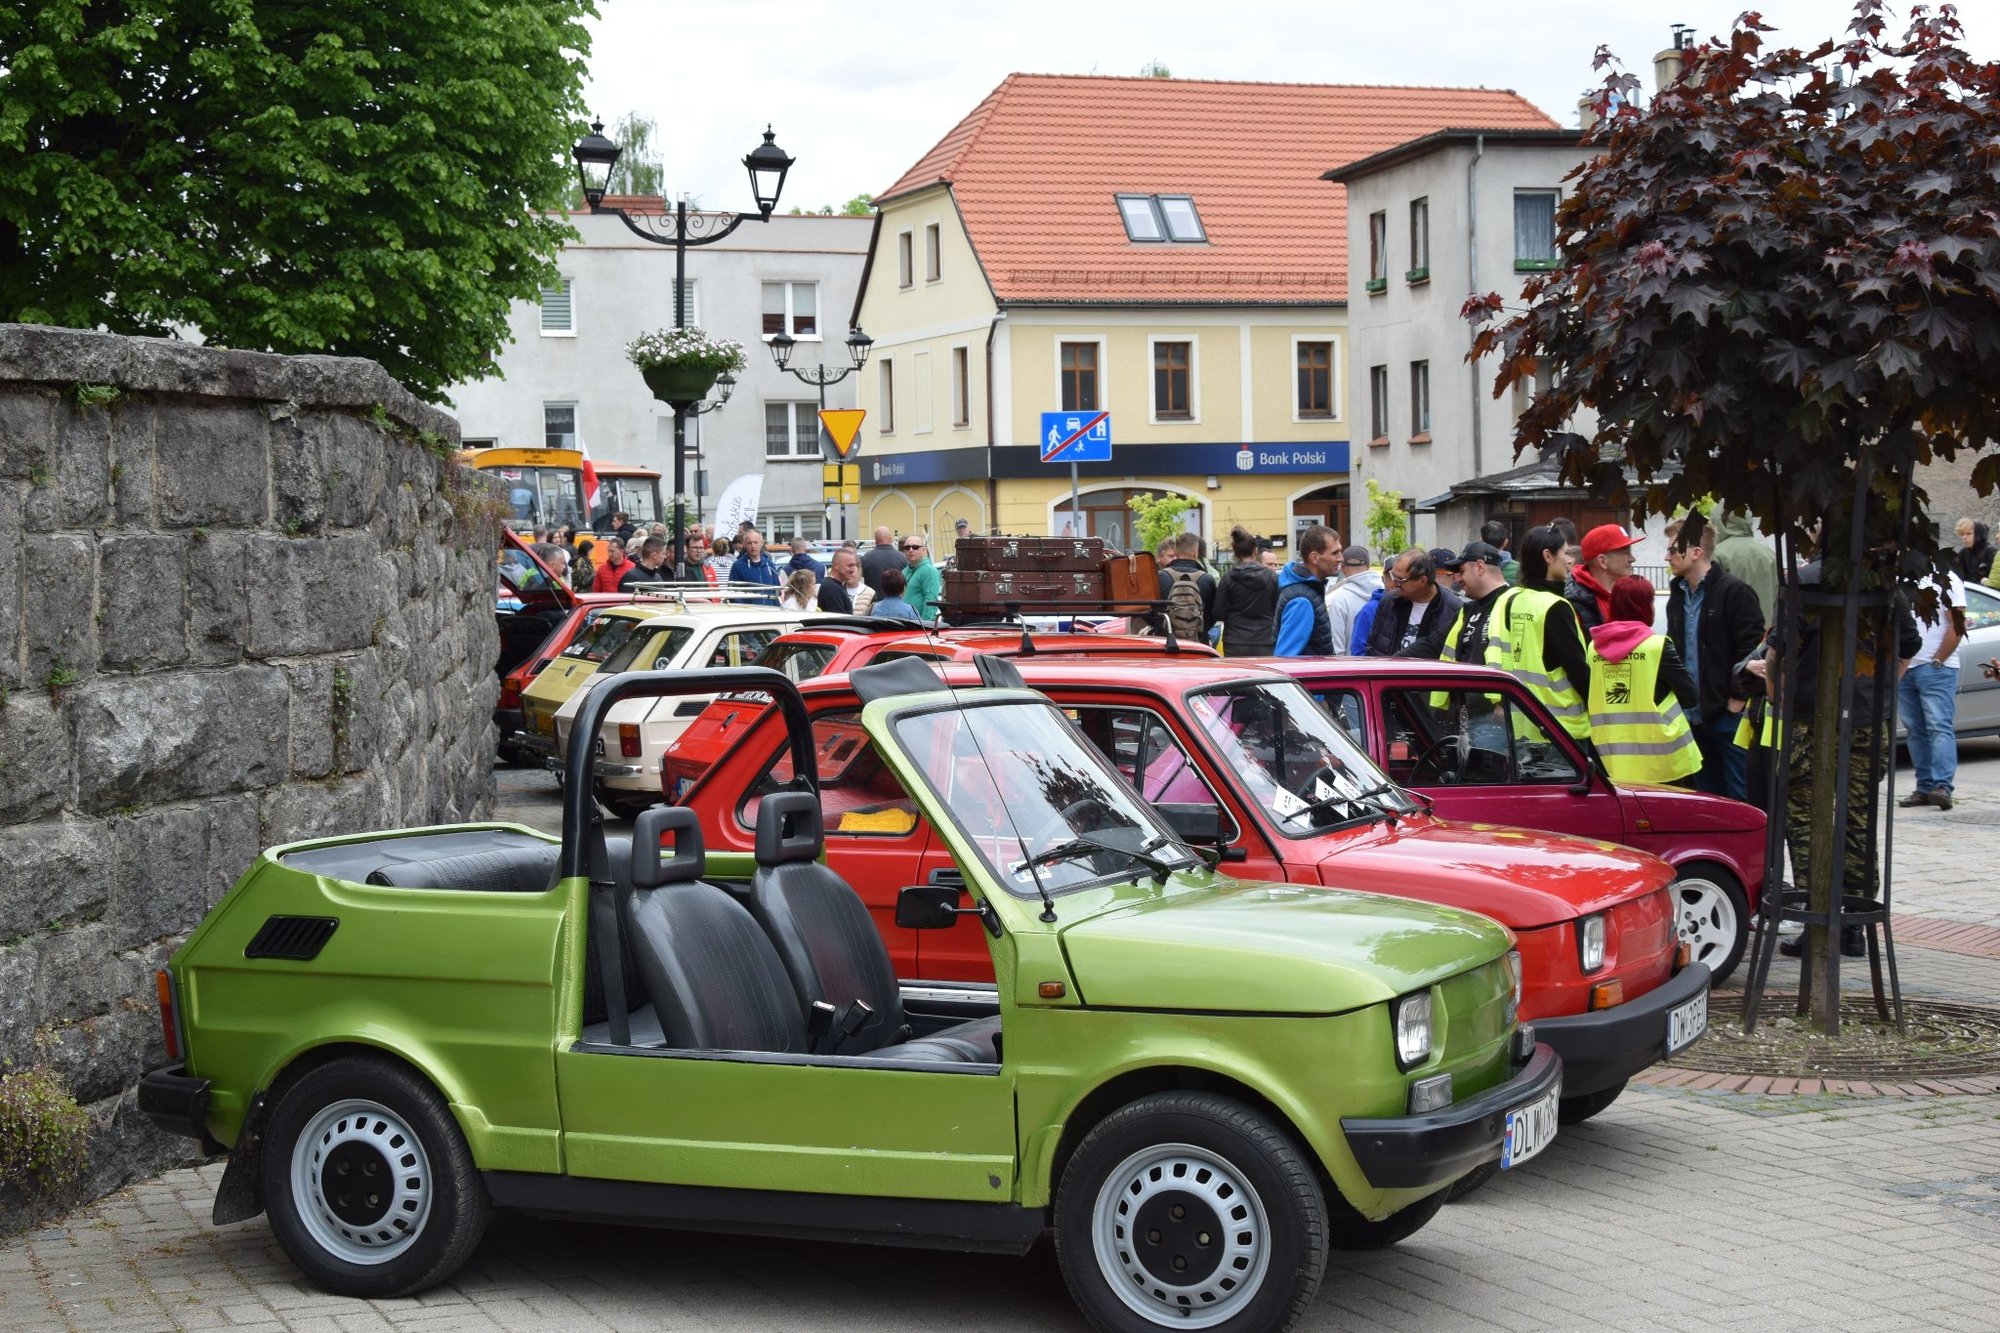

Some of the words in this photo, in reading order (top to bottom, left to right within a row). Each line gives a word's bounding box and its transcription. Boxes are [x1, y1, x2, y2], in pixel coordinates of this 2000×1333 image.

[1260, 452, 1289, 465] Bank
[1292, 451, 1326, 465] Polski
[1593, 652, 1646, 663] ORGATOR
[1513, 1106, 1542, 1159] DLW
